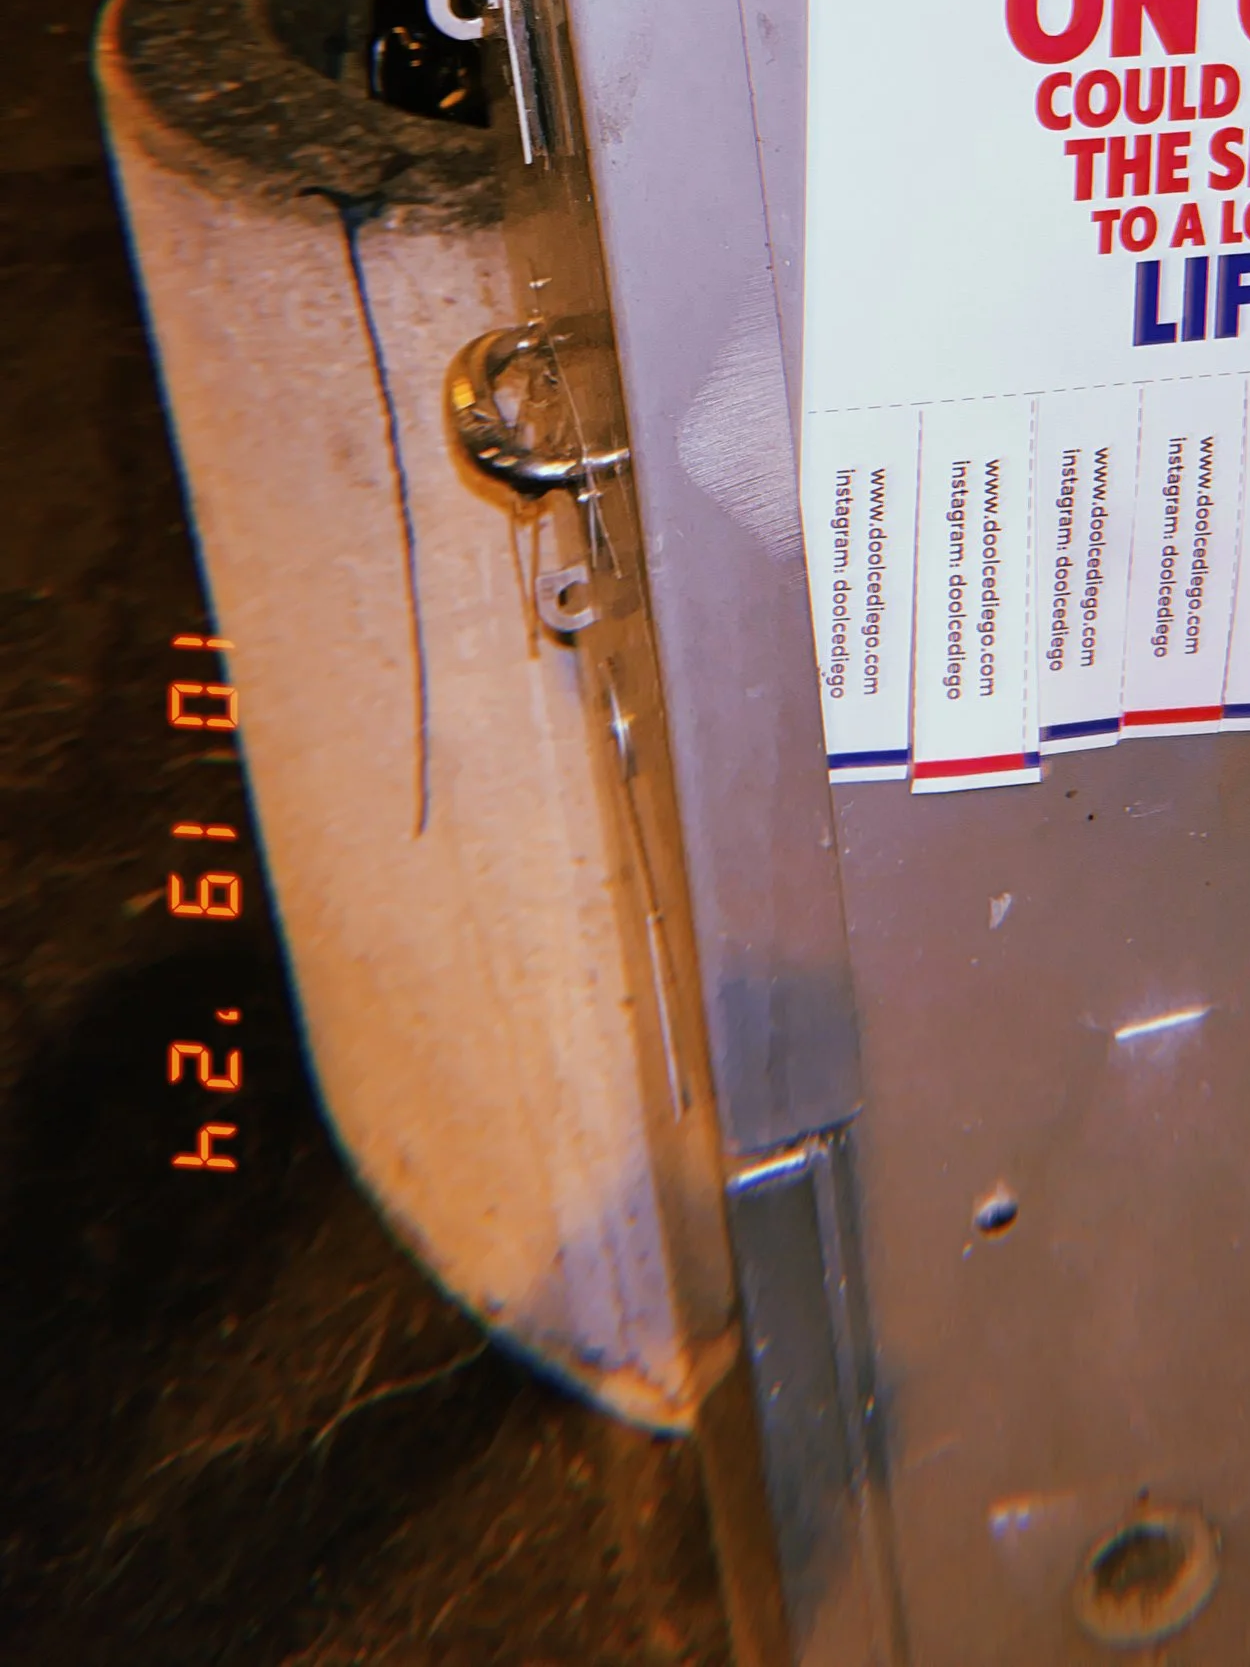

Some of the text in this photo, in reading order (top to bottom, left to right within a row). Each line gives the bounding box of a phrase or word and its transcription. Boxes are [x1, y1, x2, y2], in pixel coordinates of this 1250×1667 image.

[1036, 64, 1240, 132] COULD
[1065, 134, 1189, 201] THE
[1092, 206, 1157, 254] TO
[1170, 203, 1205, 247] A
[829, 469, 856, 698] instagram: doolcediego
[861, 469, 887, 694] www.doolcediego.com
[943, 461, 971, 699] instagram: doolcediego
[977, 459, 1001, 696] www.doolcediego.com
[1046, 449, 1081, 671] instagram: doolcediego
[1080, 448, 1108, 666] www.doolcediego.com
[1151, 438, 1187, 657] instagram: doolcediego
[1183, 437, 1214, 654] www.doolcediego.com
